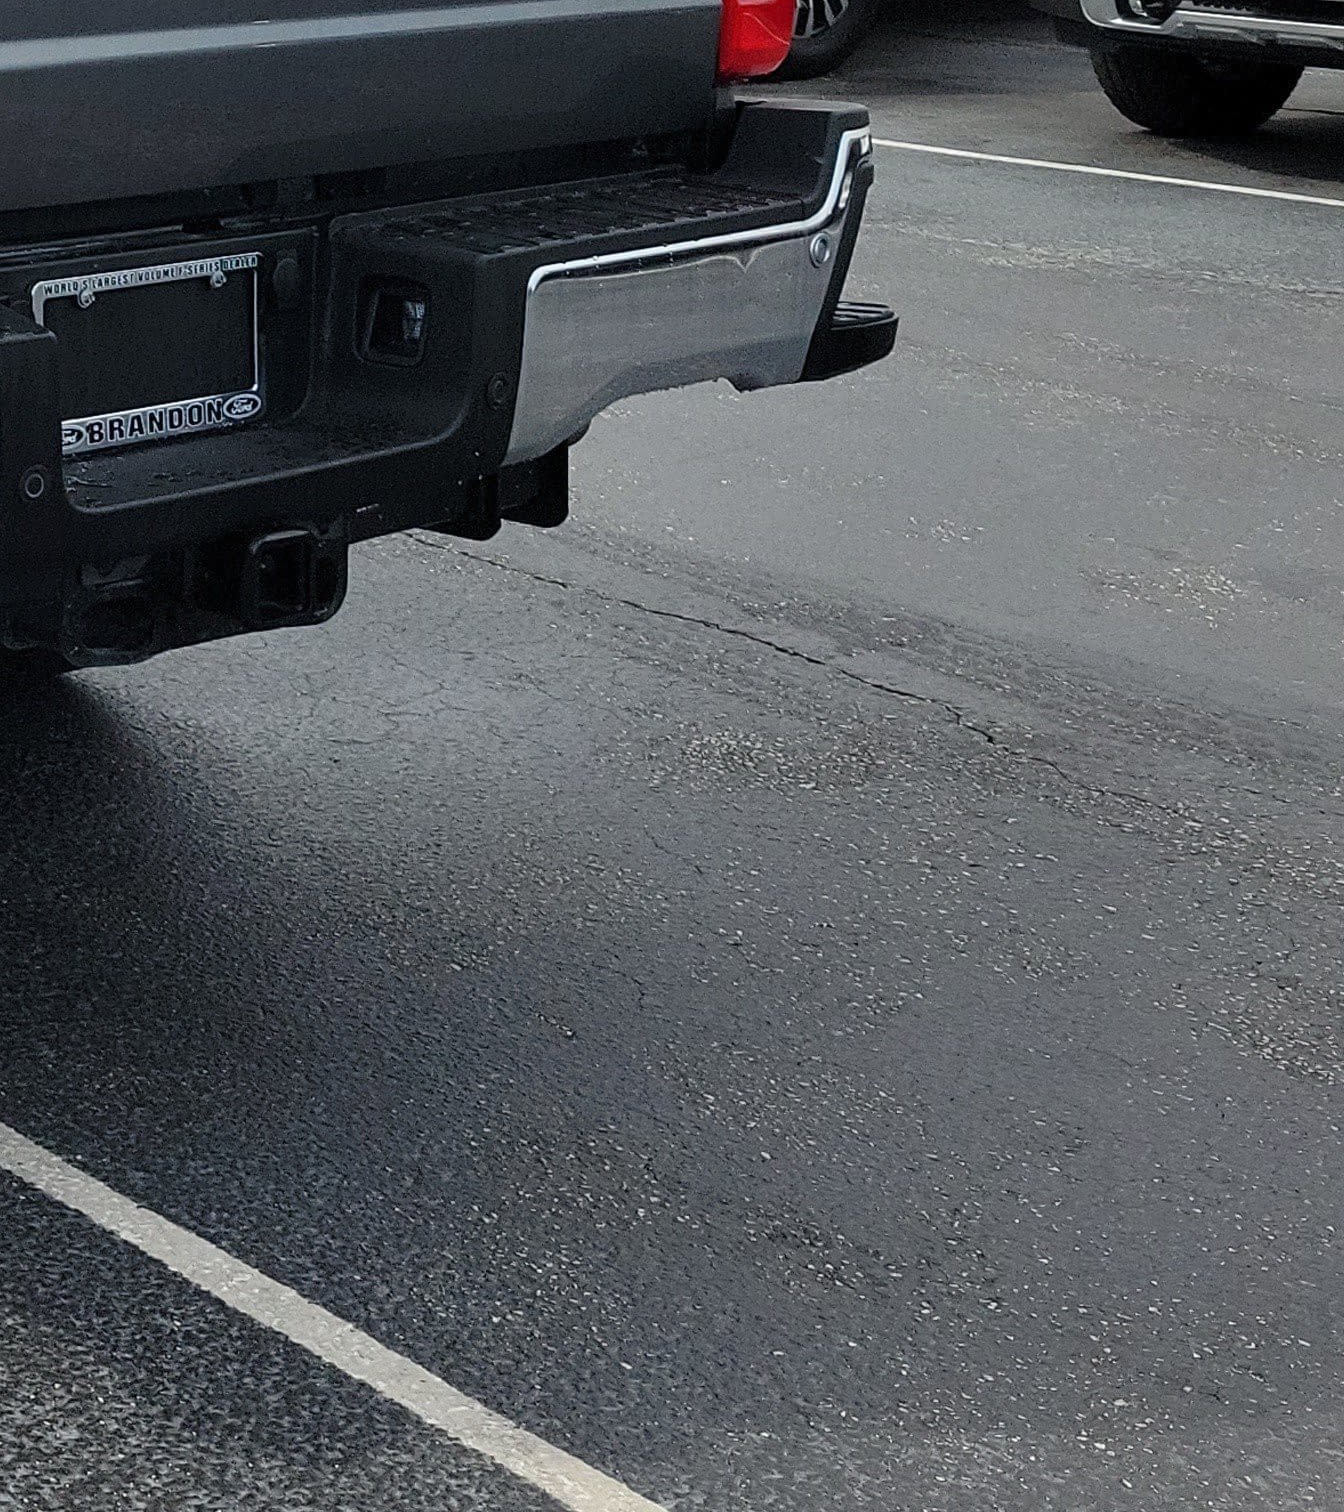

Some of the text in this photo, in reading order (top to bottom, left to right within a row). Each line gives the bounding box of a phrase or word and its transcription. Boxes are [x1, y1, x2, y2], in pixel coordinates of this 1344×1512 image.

[92, 273, 135, 289] LARGEST
[138, 267, 175, 282] VOLUME
[86, 398, 223, 445] BRANDON
[231, 399, 254, 415] Ford
